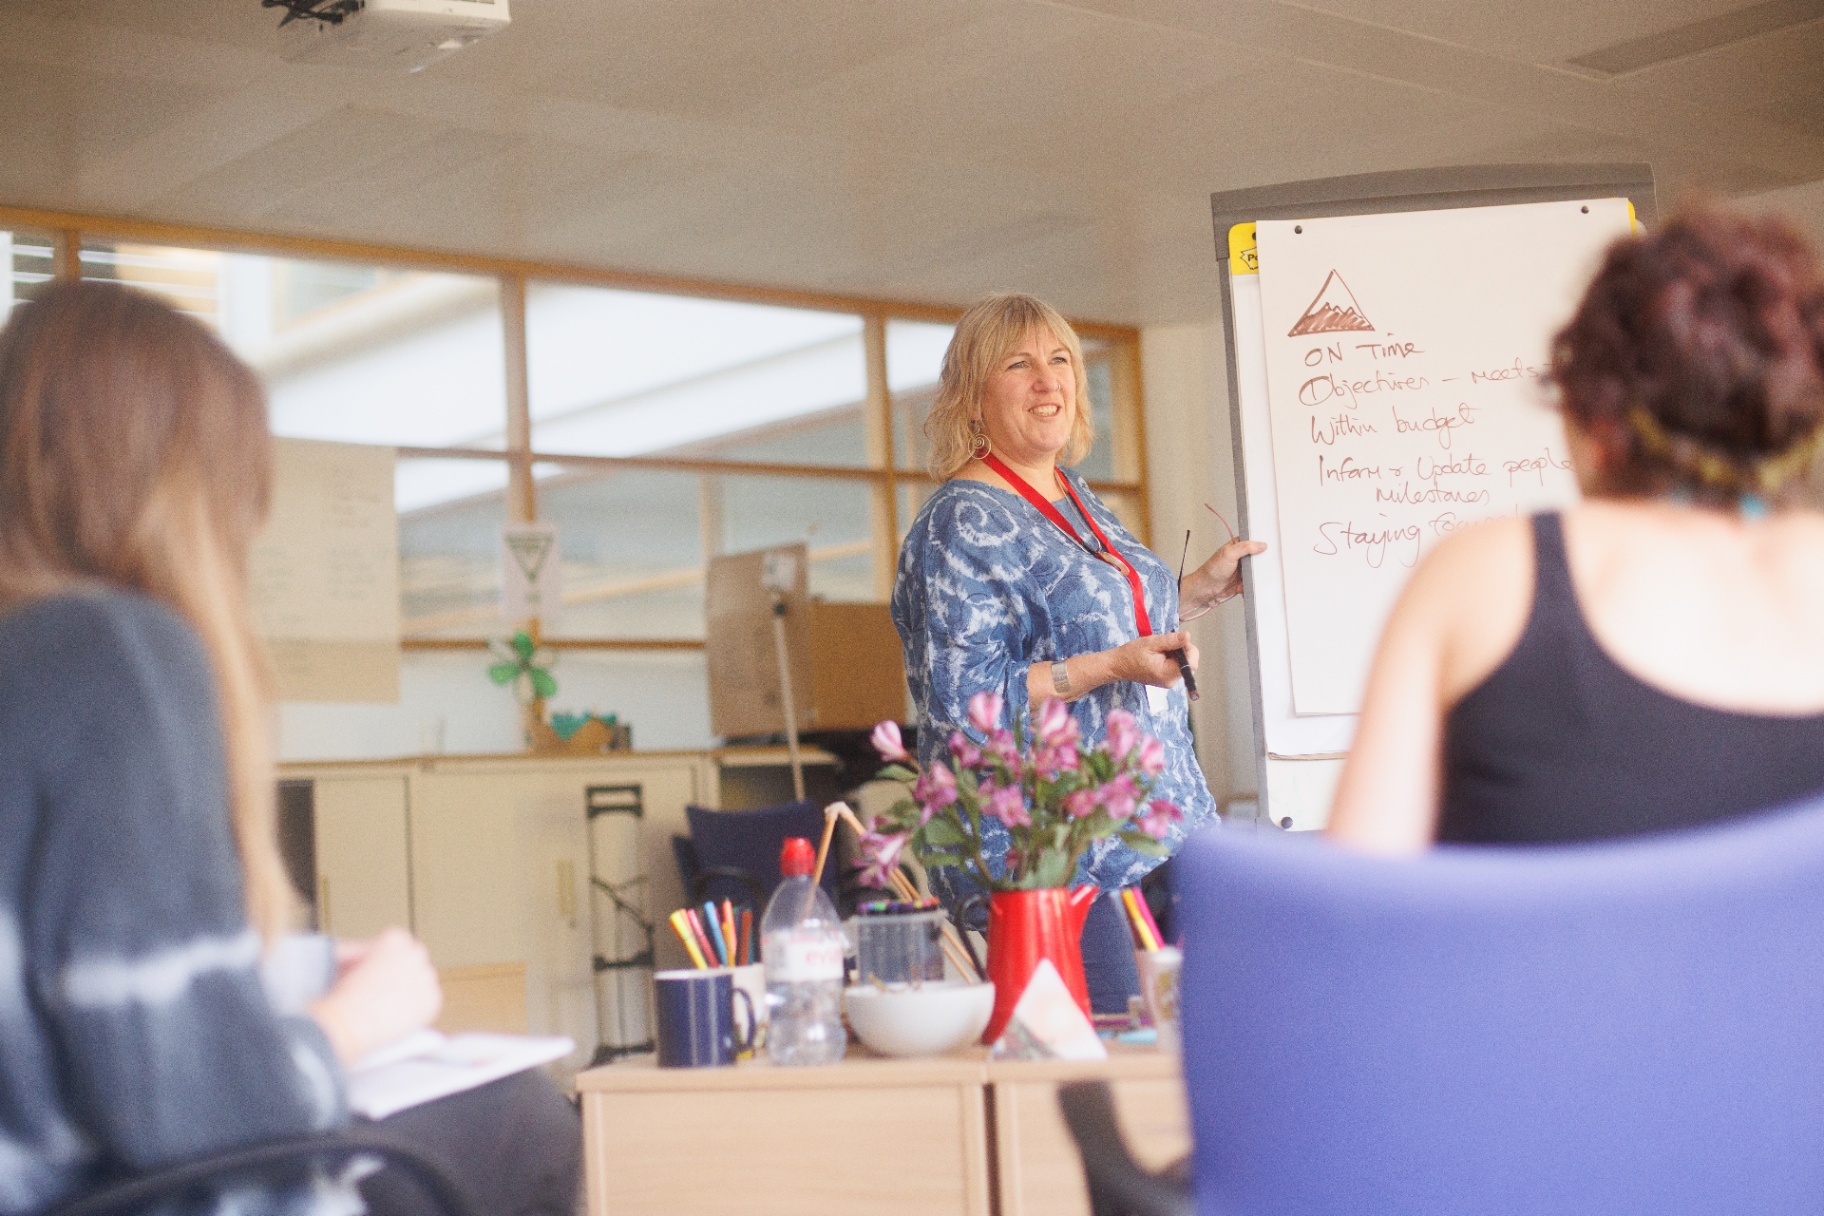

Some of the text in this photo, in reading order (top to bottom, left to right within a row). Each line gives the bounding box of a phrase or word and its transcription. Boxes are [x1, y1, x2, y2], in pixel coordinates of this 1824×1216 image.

[1304, 342, 1343, 367] ON
[1298, 369, 1430, 410] Objectives
[1311, 402, 1480, 450] Within budget
[1417, 453, 1492, 486] Update
[1502, 446, 1577, 488] people
[1313, 512, 1421, 569] Staying
